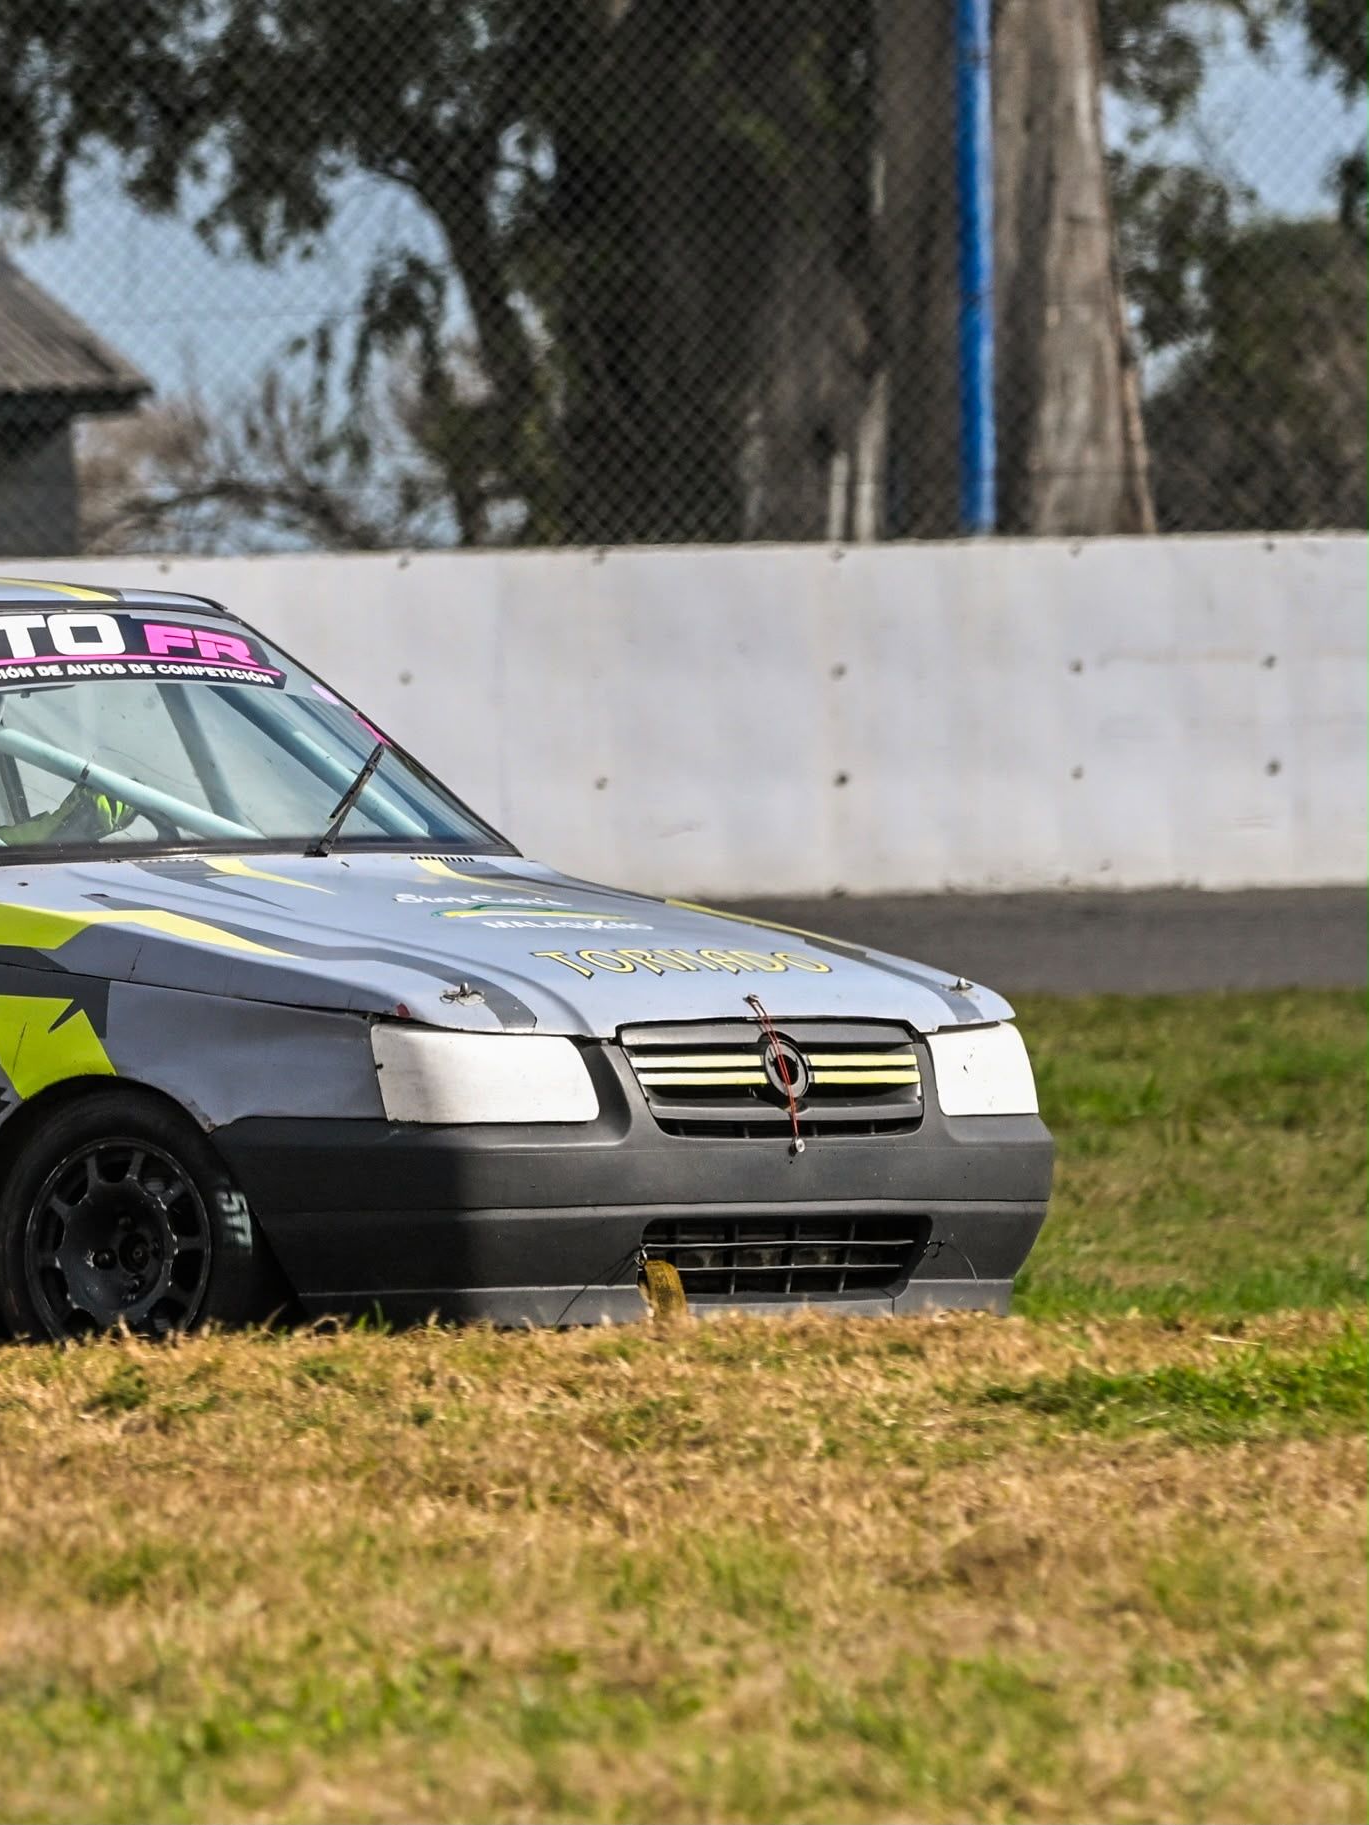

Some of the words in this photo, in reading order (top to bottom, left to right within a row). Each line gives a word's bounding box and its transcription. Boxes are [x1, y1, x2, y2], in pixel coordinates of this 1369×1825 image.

[142, 623, 260, 665] FR
[35, 665, 64, 677] DE
[66, 663, 127, 675] AUTOS
[127, 663, 156, 674] DE
[156, 664, 275, 685] COMPETICIÓN
[531, 948, 833, 980] TORNADO
